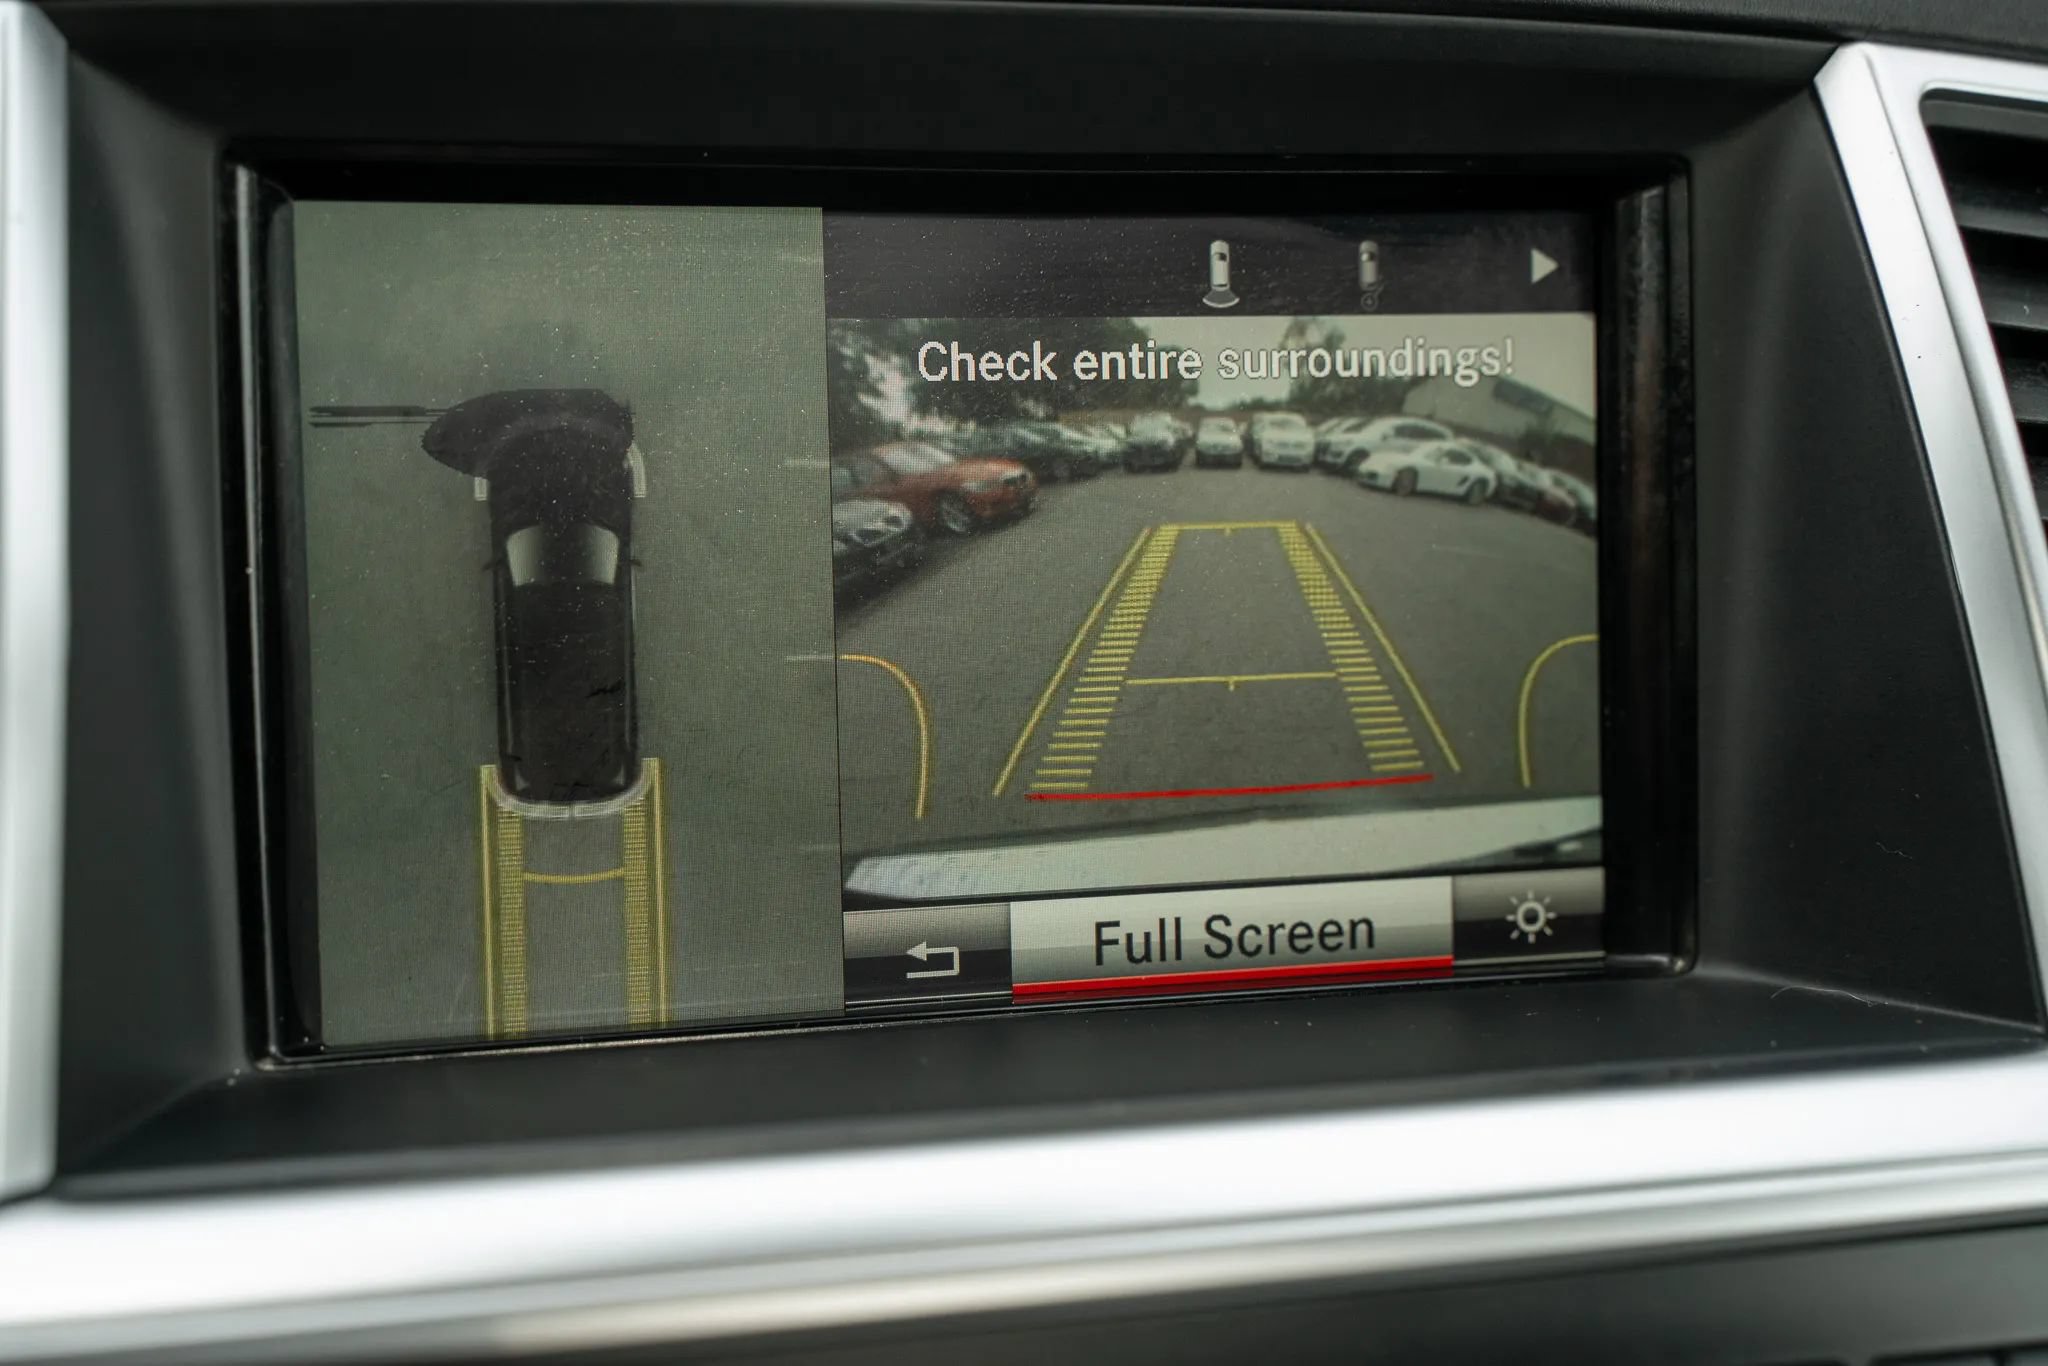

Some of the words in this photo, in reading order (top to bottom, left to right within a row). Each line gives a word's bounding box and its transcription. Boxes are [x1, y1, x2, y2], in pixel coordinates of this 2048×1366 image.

[917, 340, 1058, 383] Check
[1073, 339, 1202, 382] entire
[1217, 337, 1515, 388] surroundings!
[1094, 917, 1184, 966] Full
[1203, 912, 1376, 960] Screen
